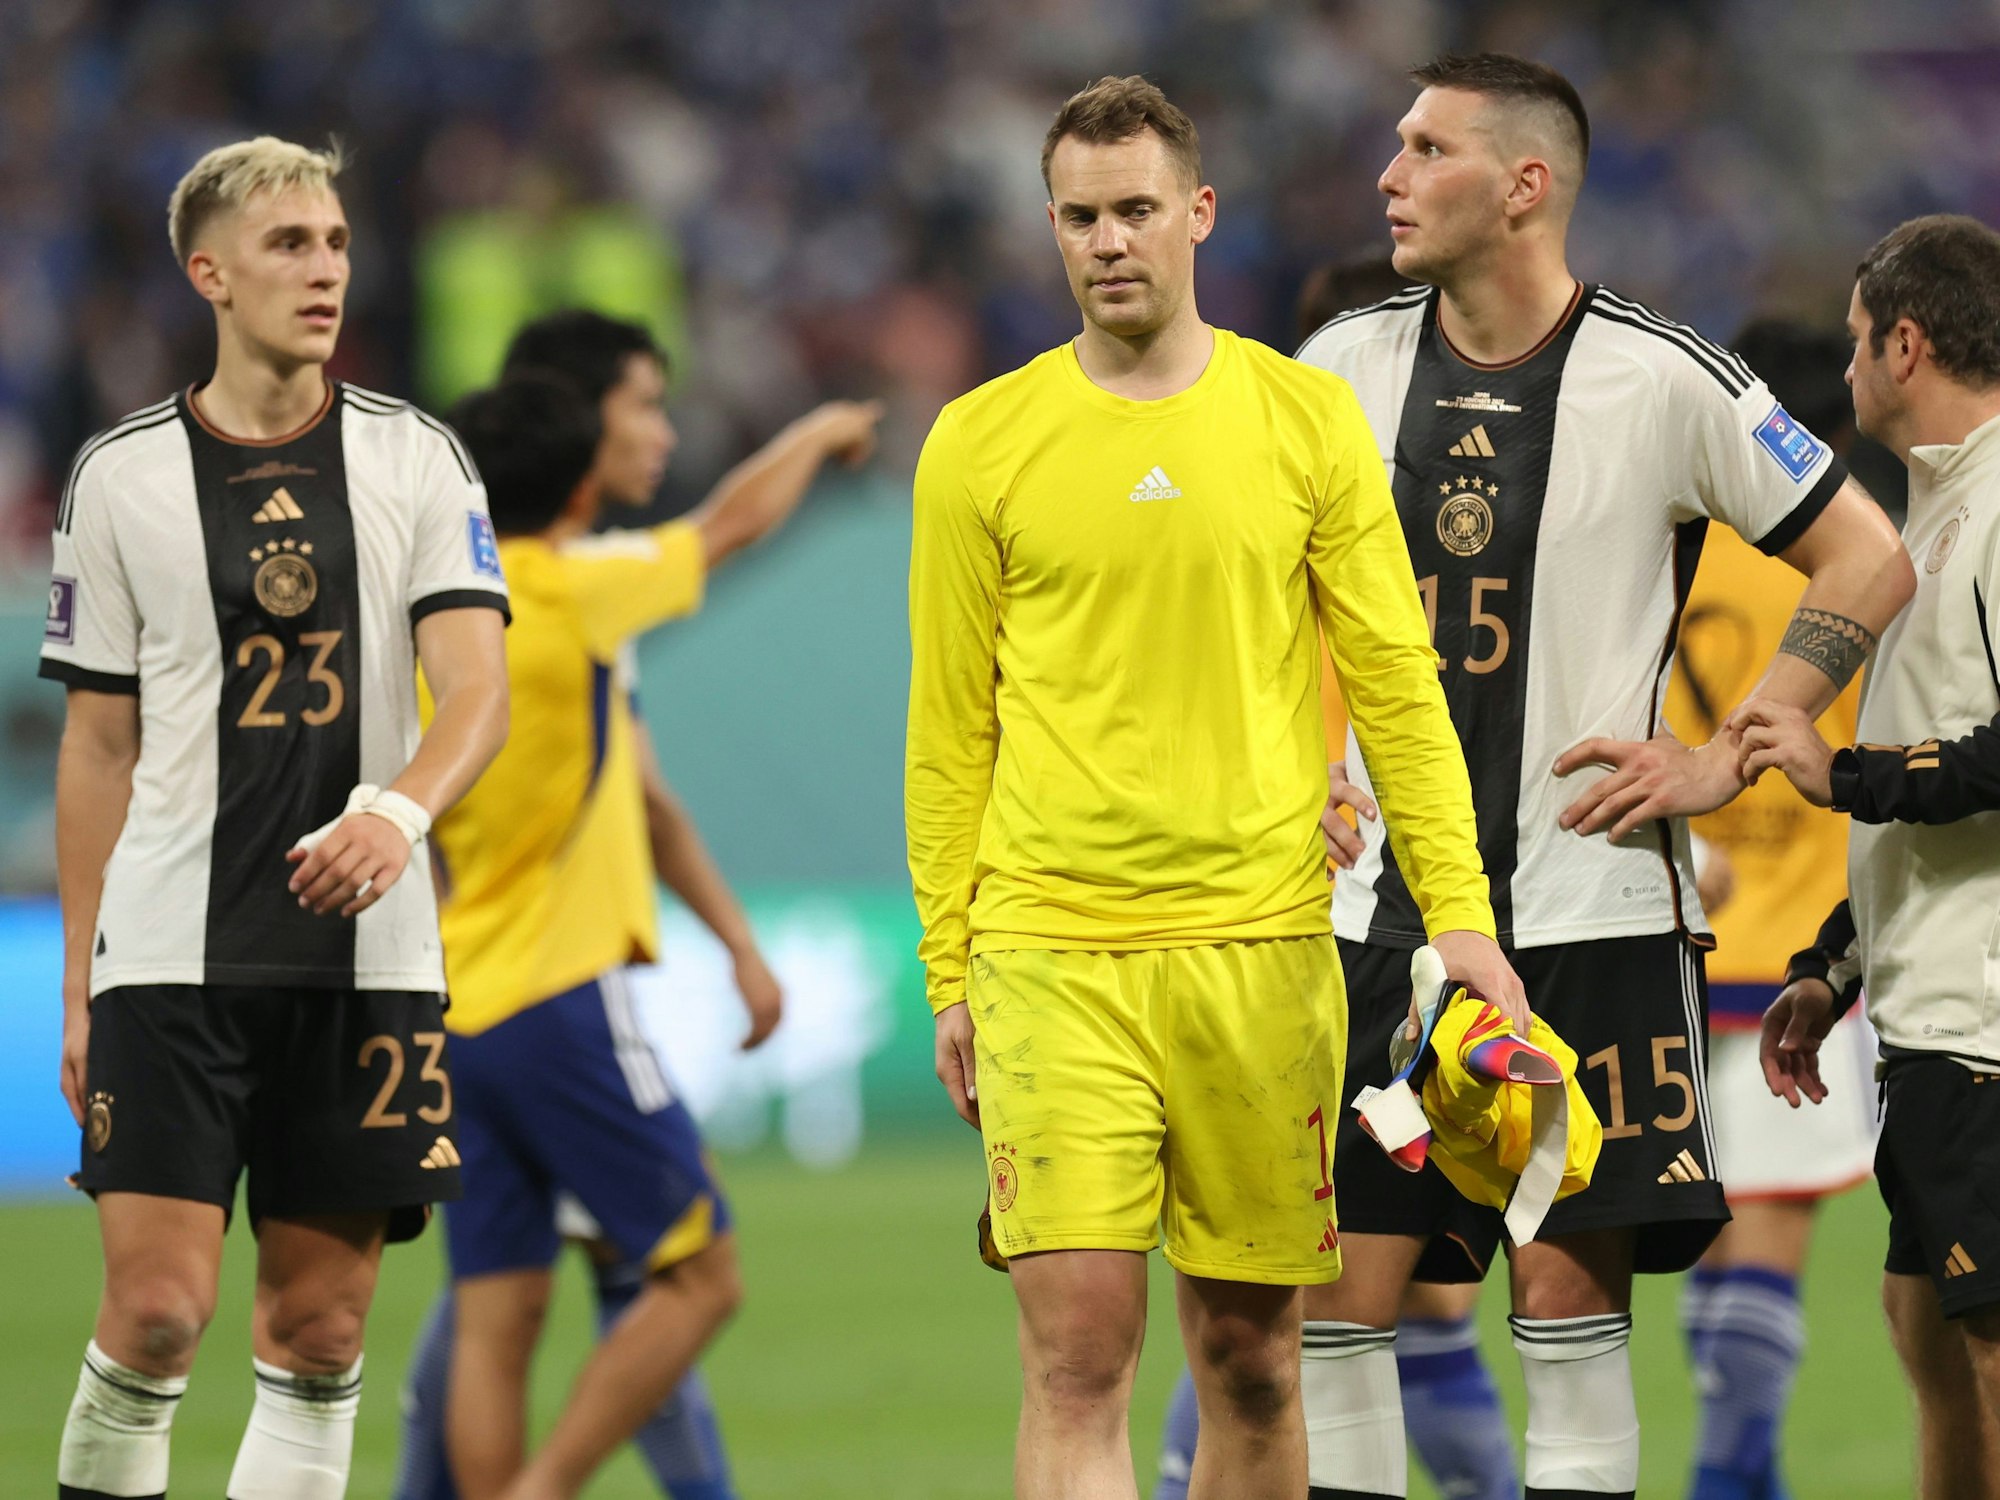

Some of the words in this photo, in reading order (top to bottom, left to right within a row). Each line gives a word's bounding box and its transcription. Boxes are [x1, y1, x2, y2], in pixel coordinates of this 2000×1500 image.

[1129, 488, 1182, 502] adidas
[1416, 574, 1510, 674] 15
[237, 629, 344, 728] 23
[358, 1032, 452, 1129] 23
[1586, 1035, 1696, 1140] 15
[1308, 1103, 1333, 1201] 1
